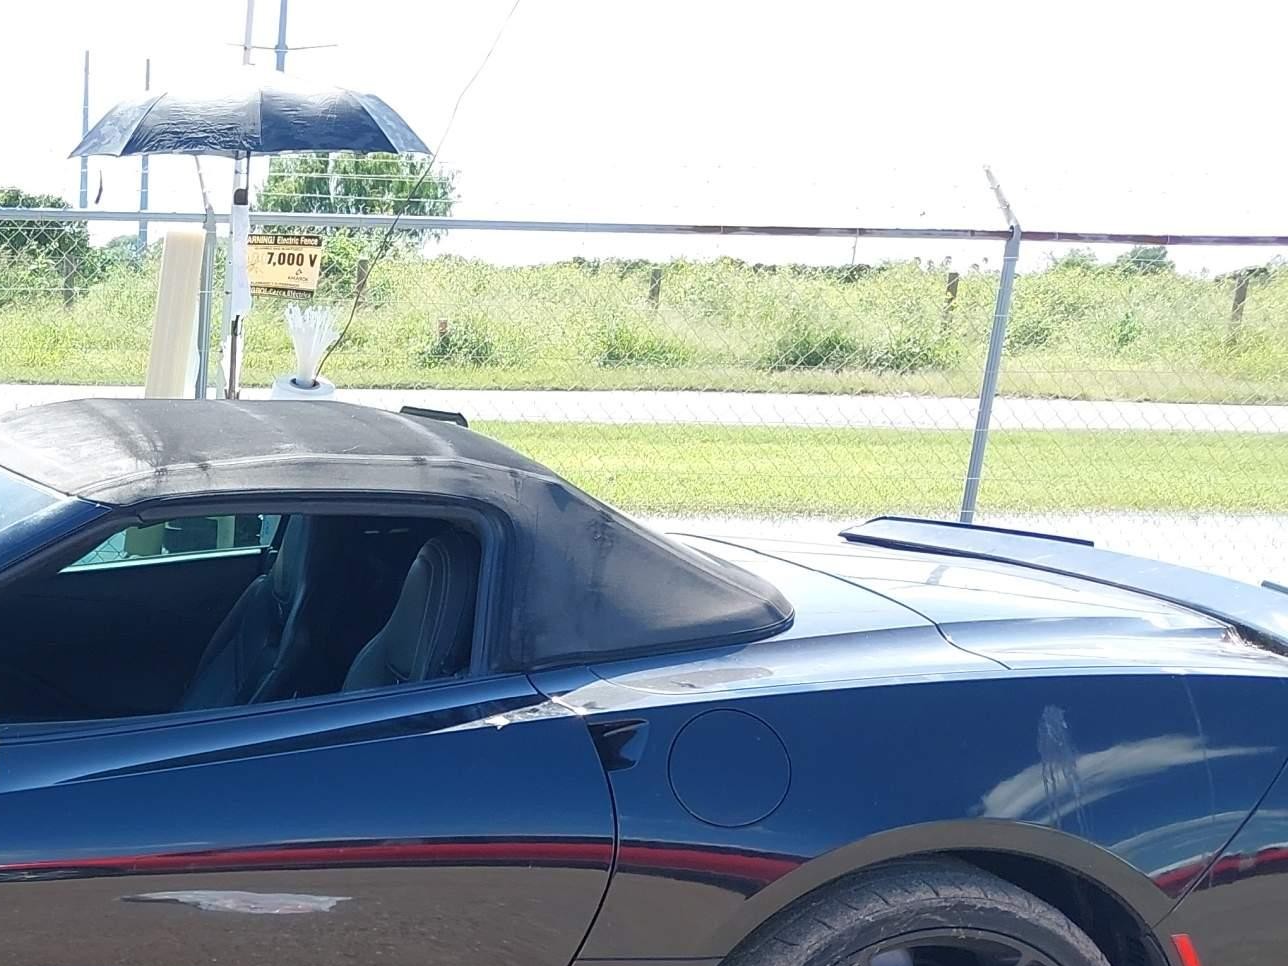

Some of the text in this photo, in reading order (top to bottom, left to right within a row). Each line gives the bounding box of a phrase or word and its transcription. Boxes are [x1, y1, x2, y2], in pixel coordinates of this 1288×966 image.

[247, 235, 318, 246] ARNING! Electric Fence
[267, 252, 318, 267] 7,000 V
